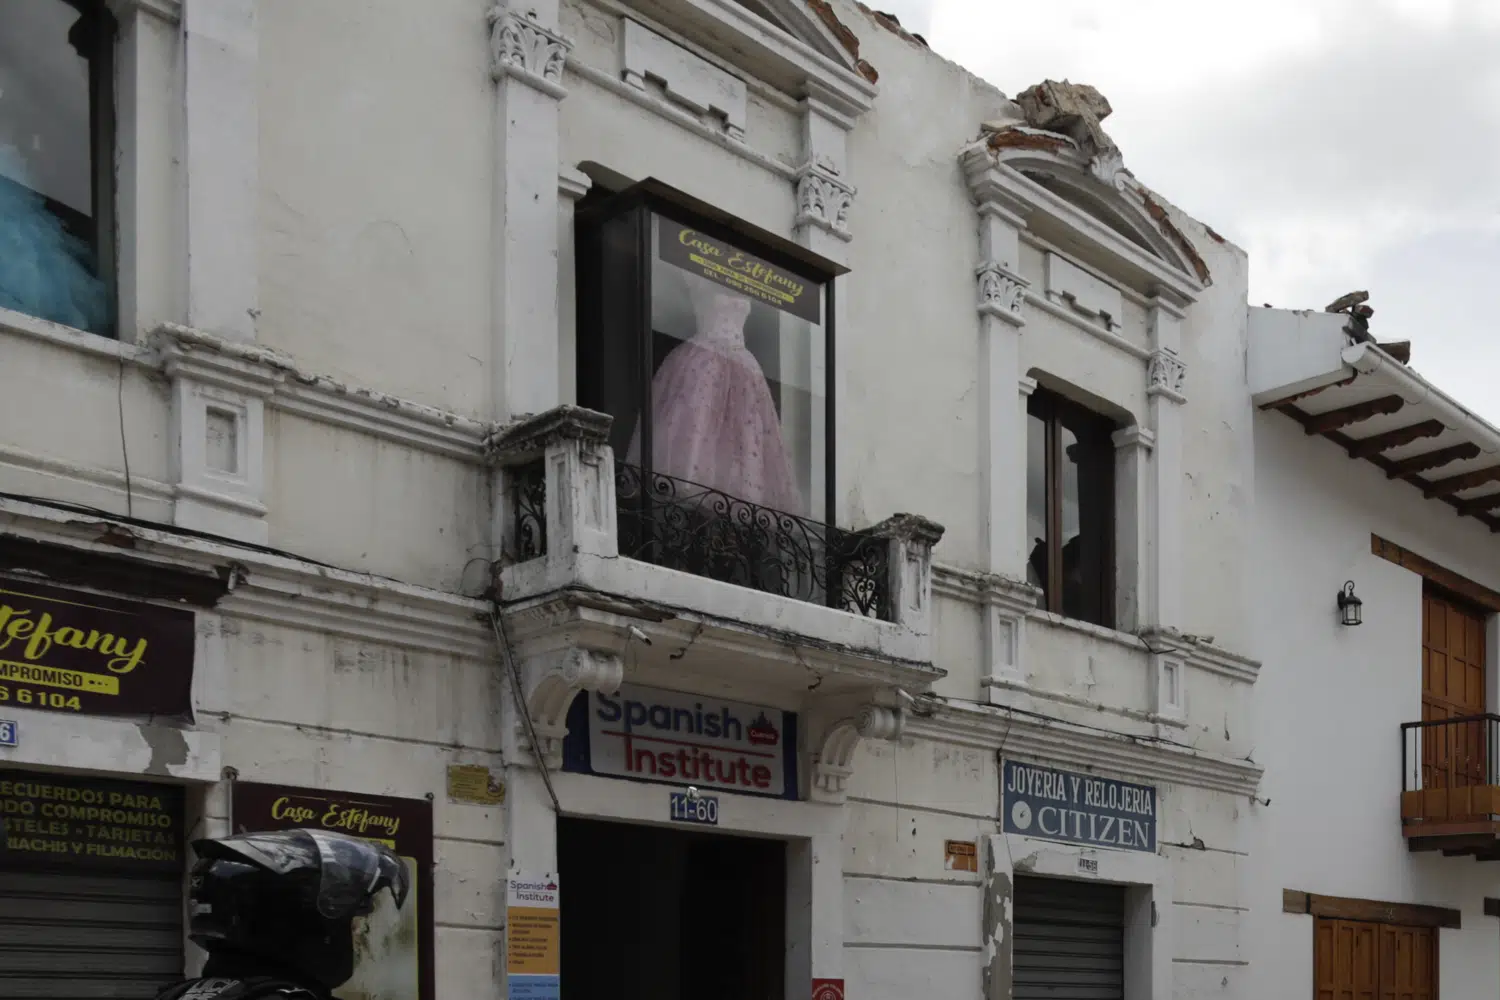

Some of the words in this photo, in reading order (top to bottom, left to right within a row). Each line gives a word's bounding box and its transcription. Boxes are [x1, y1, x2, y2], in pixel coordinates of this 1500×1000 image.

[16, 689, 82, 711] 6104
[597, 691, 742, 741] Spanish
[624, 735, 772, 788] Institute
[108, 791, 162, 811] PARA
[1008, 766, 1067, 801] JOYERIA
[1070, 776, 1081, 804] Y
[1084, 779, 1153, 816] RELOJERIA
[41, 802, 172, 828] COMPROMISO
[271, 797, 318, 822] Casa
[321, 804, 400, 835] Estefany
[671, 796, 718, 822] 11-60
[1038, 806, 1150, 848] CITIZEN
[510, 880, 548, 892] Spanish
[516, 891, 555, 902] Institute
